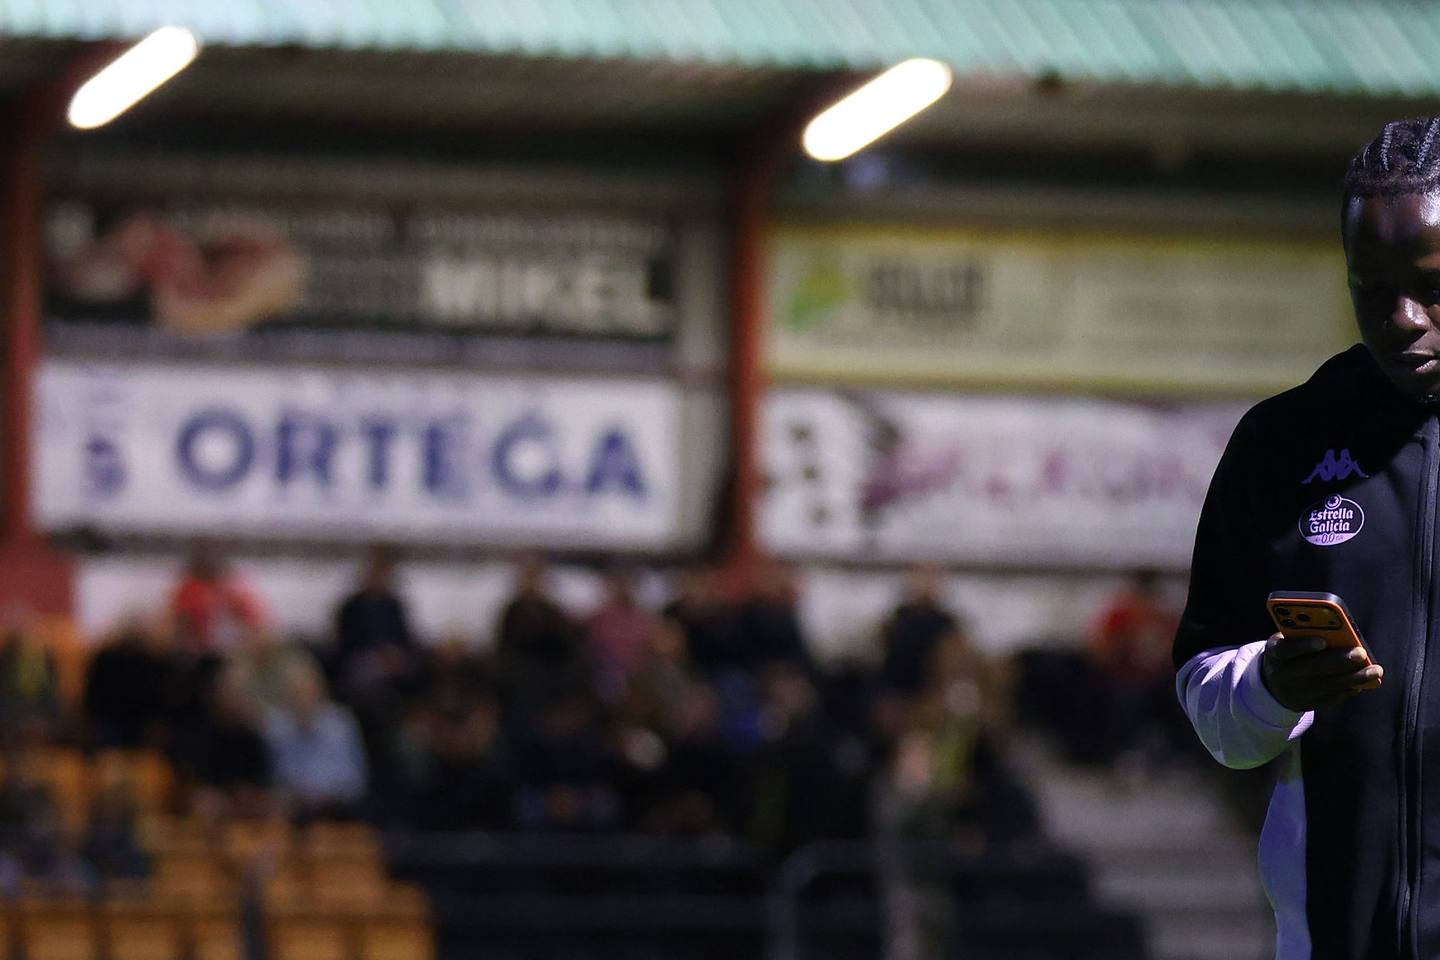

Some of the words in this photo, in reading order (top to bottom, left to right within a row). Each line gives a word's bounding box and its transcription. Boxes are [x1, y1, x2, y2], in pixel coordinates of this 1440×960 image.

[175, 407, 648, 498] ORTEGA
[1309, 508, 1353, 522] Estrella
[1310, 519, 1350, 534] Galicia
